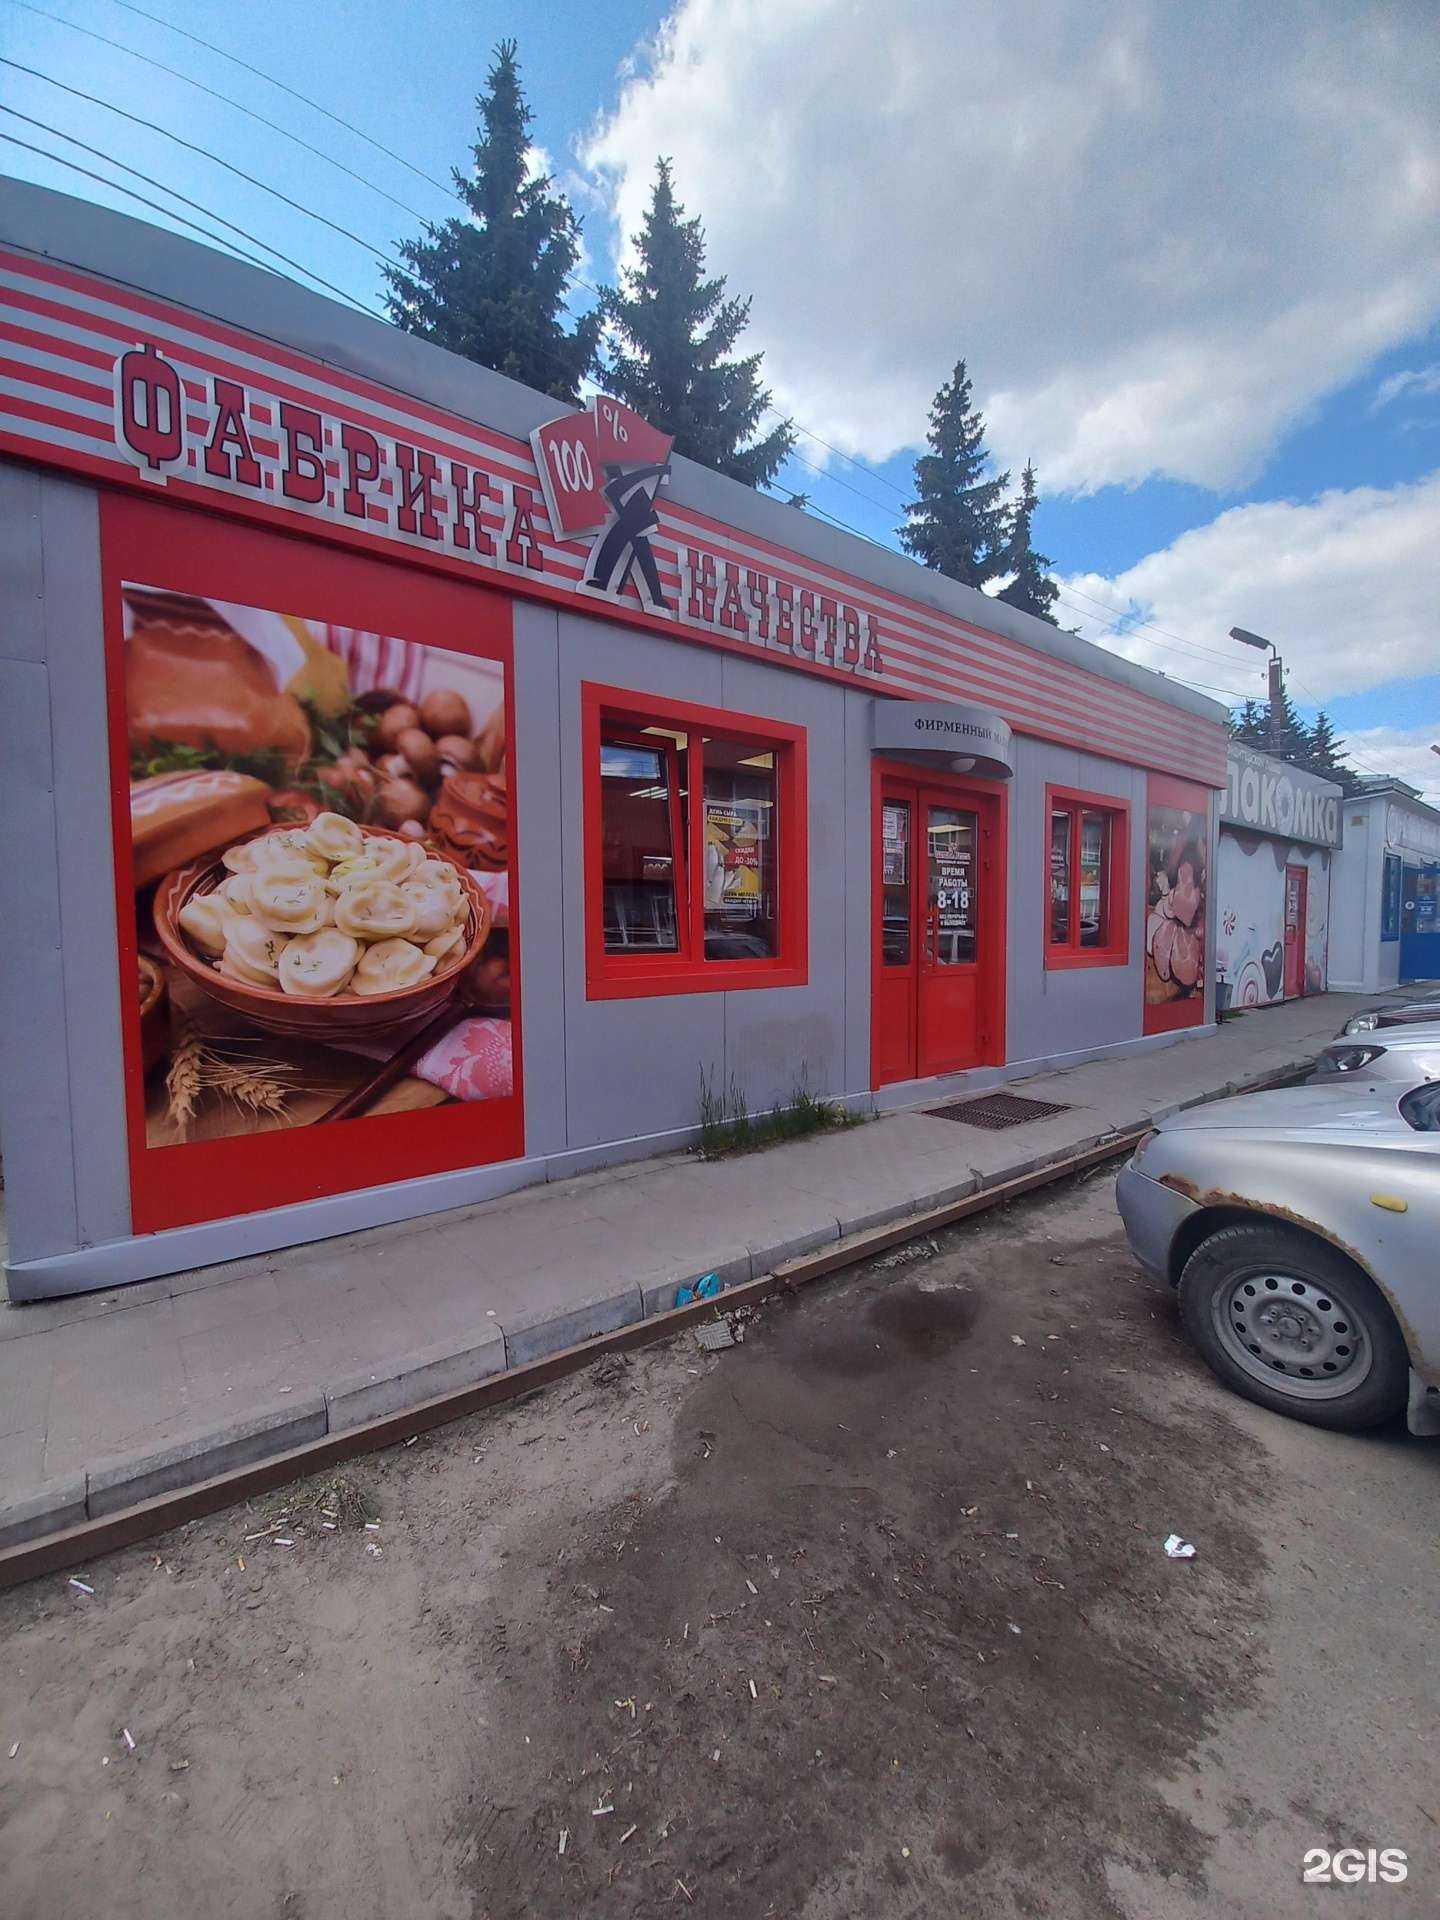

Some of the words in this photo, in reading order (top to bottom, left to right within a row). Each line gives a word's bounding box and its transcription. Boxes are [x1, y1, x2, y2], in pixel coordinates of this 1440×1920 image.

[116, 343, 545, 573] ФАБРИКА
[549, 438, 594, 493] 100
[603, 404, 629, 443] %
[686, 547, 884, 674] КАЧЕСТВА
[914, 718, 992, 740] ФИРМЕННЫЙ
[938, 878, 968, 887] РАБОТЫ
[941, 867, 965, 876] ВРЕМЯ
[937, 890, 969, 909] 8-18
